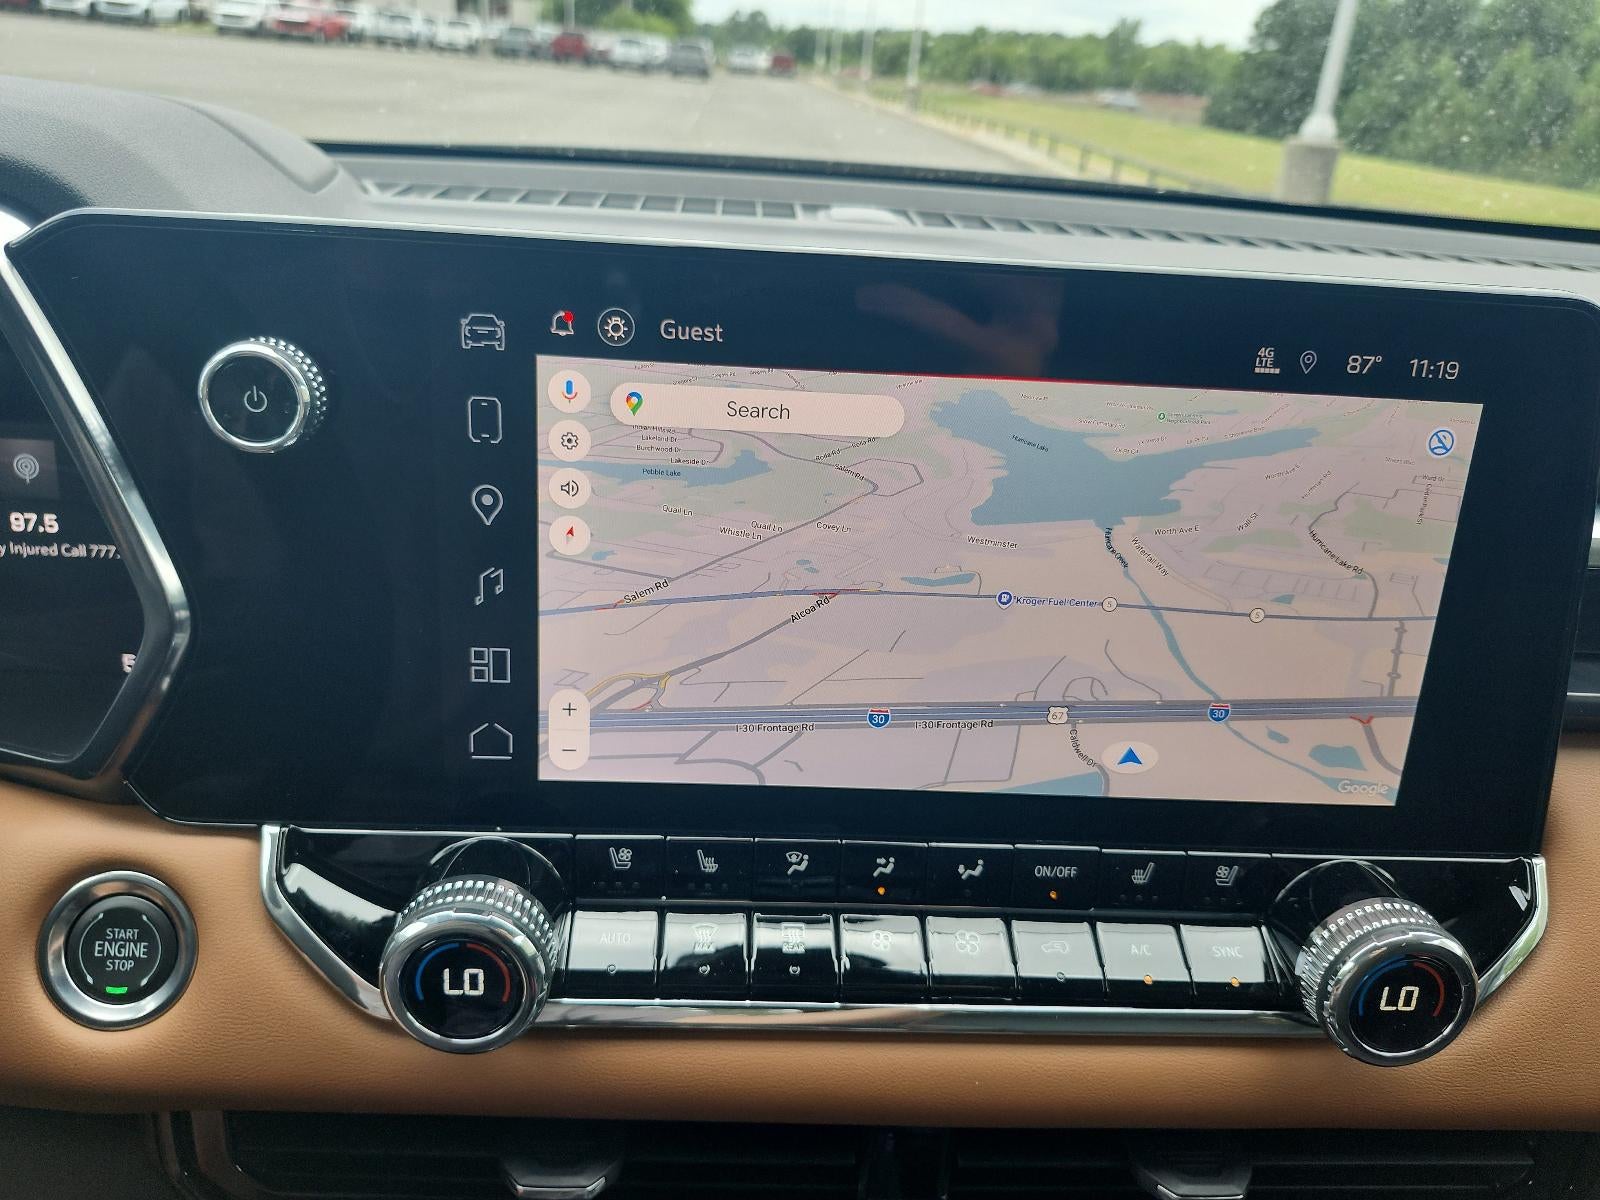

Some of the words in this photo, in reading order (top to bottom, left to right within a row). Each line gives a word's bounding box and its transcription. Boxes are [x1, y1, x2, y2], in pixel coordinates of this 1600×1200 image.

[660, 319, 723, 342] Guest
[1257, 347, 1275, 358] 4G
[1255, 357, 1274, 368] LTE
[1347, 355, 1382, 374] 87°
[1409, 358, 1460, 380] 11:19
[727, 400, 790, 420] Search
[641, 434, 669, 442] Lakeland
[636, 444, 673, 453] Burchwood
[670, 457, 700, 465] Lakeside
[642, 468, 665, 476] Pebble
[666, 469, 681, 477] Lake
[662, 504, 682, 515] Quail
[683, 508, 693, 517] Ln
[9, 511, 60, 534] 97.5
[751, 520, 771, 532] Quail
[771, 523, 783, 533] Ln
[816, 521, 840, 533] Covey
[841, 525, 851, 533] Ln
[1236, 518, 1250, 532] Wall
[1250, 511, 1259, 523] St
[719, 526, 750, 539] Whistle
[751, 532, 762, 541] Ln
[1153, 527, 1177, 536] Worth
[1178, 526, 1194, 534] Ave
[967, 535, 1018, 549] Westminster
[9, 540, 59, 558] Injured
[61, 542, 87, 558] Call
[1308, 529, 1337, 560] Hurricane
[1335, 555, 1352, 570] Lake
[1351, 564, 1364, 576] Rd
[1131, 536, 1157, 565] Waterfall
[1155, 562, 1169, 577] Way
[623, 587, 655, 604] Salem
[655, 579, 669, 591] Rd
[1015, 596, 1047, 607] Kroger
[1048, 597, 1067, 606] Fuel
[1068, 598, 1098, 608] Center
[790, 605, 817, 623] Alcoa
[816, 596, 831, 608] Rd
[871, 715, 885, 724] 30
[1051, 711, 1064, 720] 67
[1212, 709, 1225, 719] 30
[757, 723, 800, 734] Frontage
[801, 723, 815, 732] Rd
[936, 721, 979, 731] Frontage
[980, 719, 994, 728] Rd
[1069, 728, 1089, 763] Caldwell
[1086, 757, 1097, 768] Dr
[1337, 780, 1389, 796] Google
[1034, 866, 1077, 878] ON/OFF
[105, 928, 139, 939] START
[599, 933, 631, 944] AUTO
[94, 941, 148, 958] ENGINE
[782, 942, 806, 953] REAR
[1131, 944, 1152, 955] A/C
[1212, 946, 1243, 958] SYNC
[105, 959, 135, 971] STOP
[443, 967, 485, 997] LO
[1379, 986, 1420, 1012] LO
